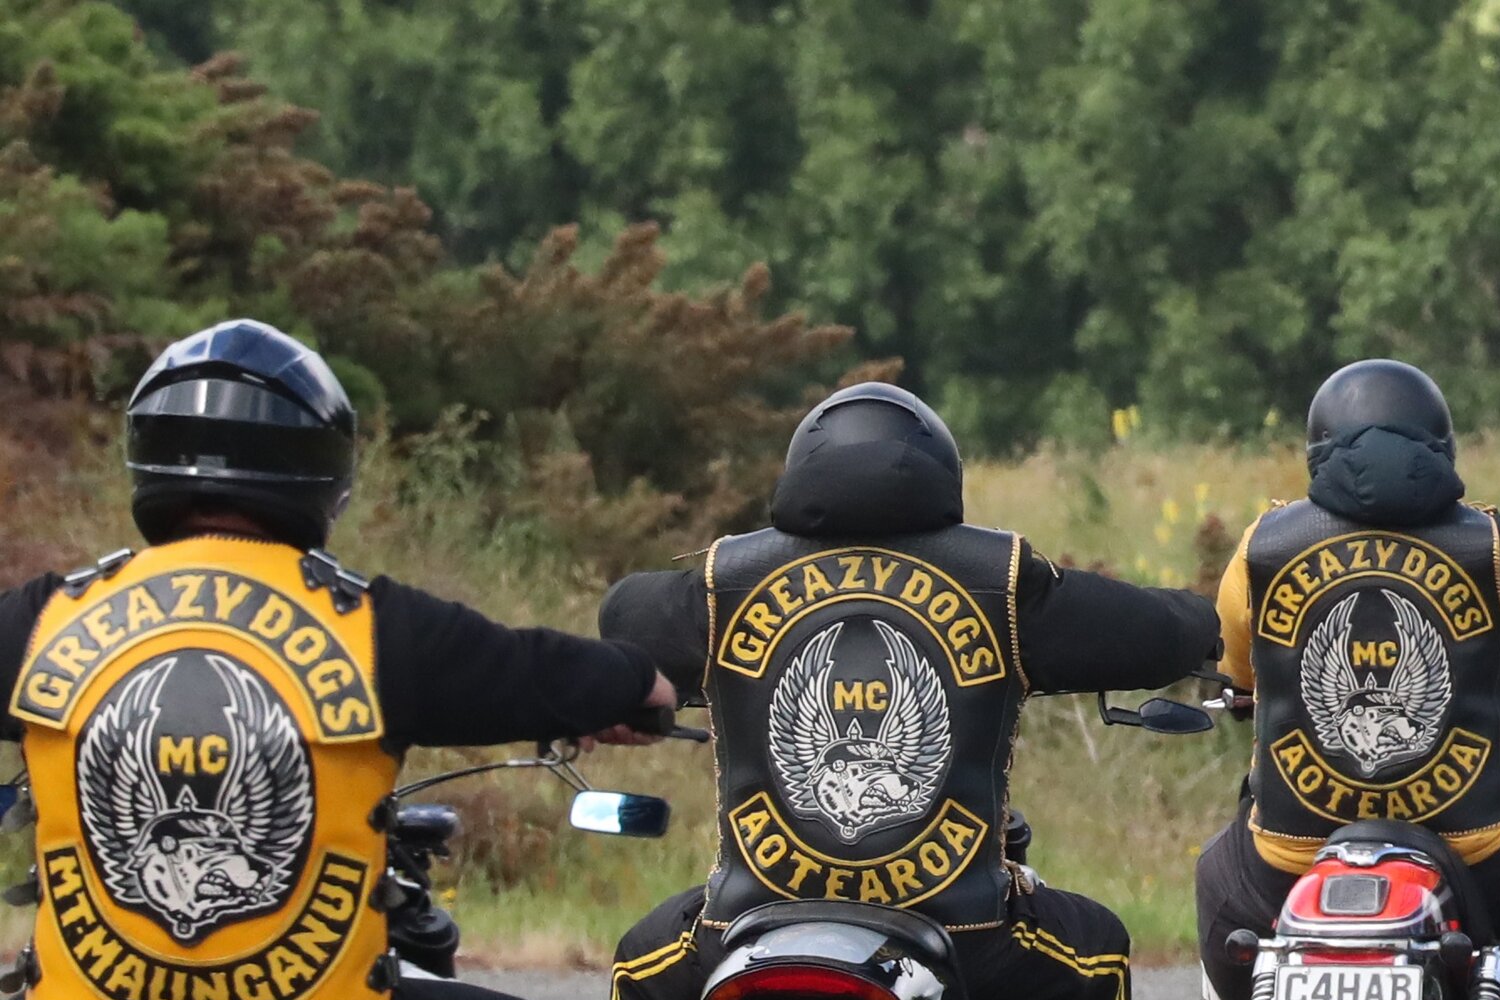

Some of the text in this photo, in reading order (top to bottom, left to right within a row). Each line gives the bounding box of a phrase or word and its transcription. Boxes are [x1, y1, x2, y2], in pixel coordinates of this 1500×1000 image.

[731, 555, 997, 675] GREAZY DOGS
[1265, 539, 1483, 634] GREAZY DOGS
[26, 573, 371, 733] GREAZY DOGS
[833, 680, 888, 711] MC
[1352, 640, 1399, 667] MC
[158, 734, 229, 776] MC
[1278, 742, 1482, 821] AOTEAROA
[738, 808, 976, 904] AOTEAROA
